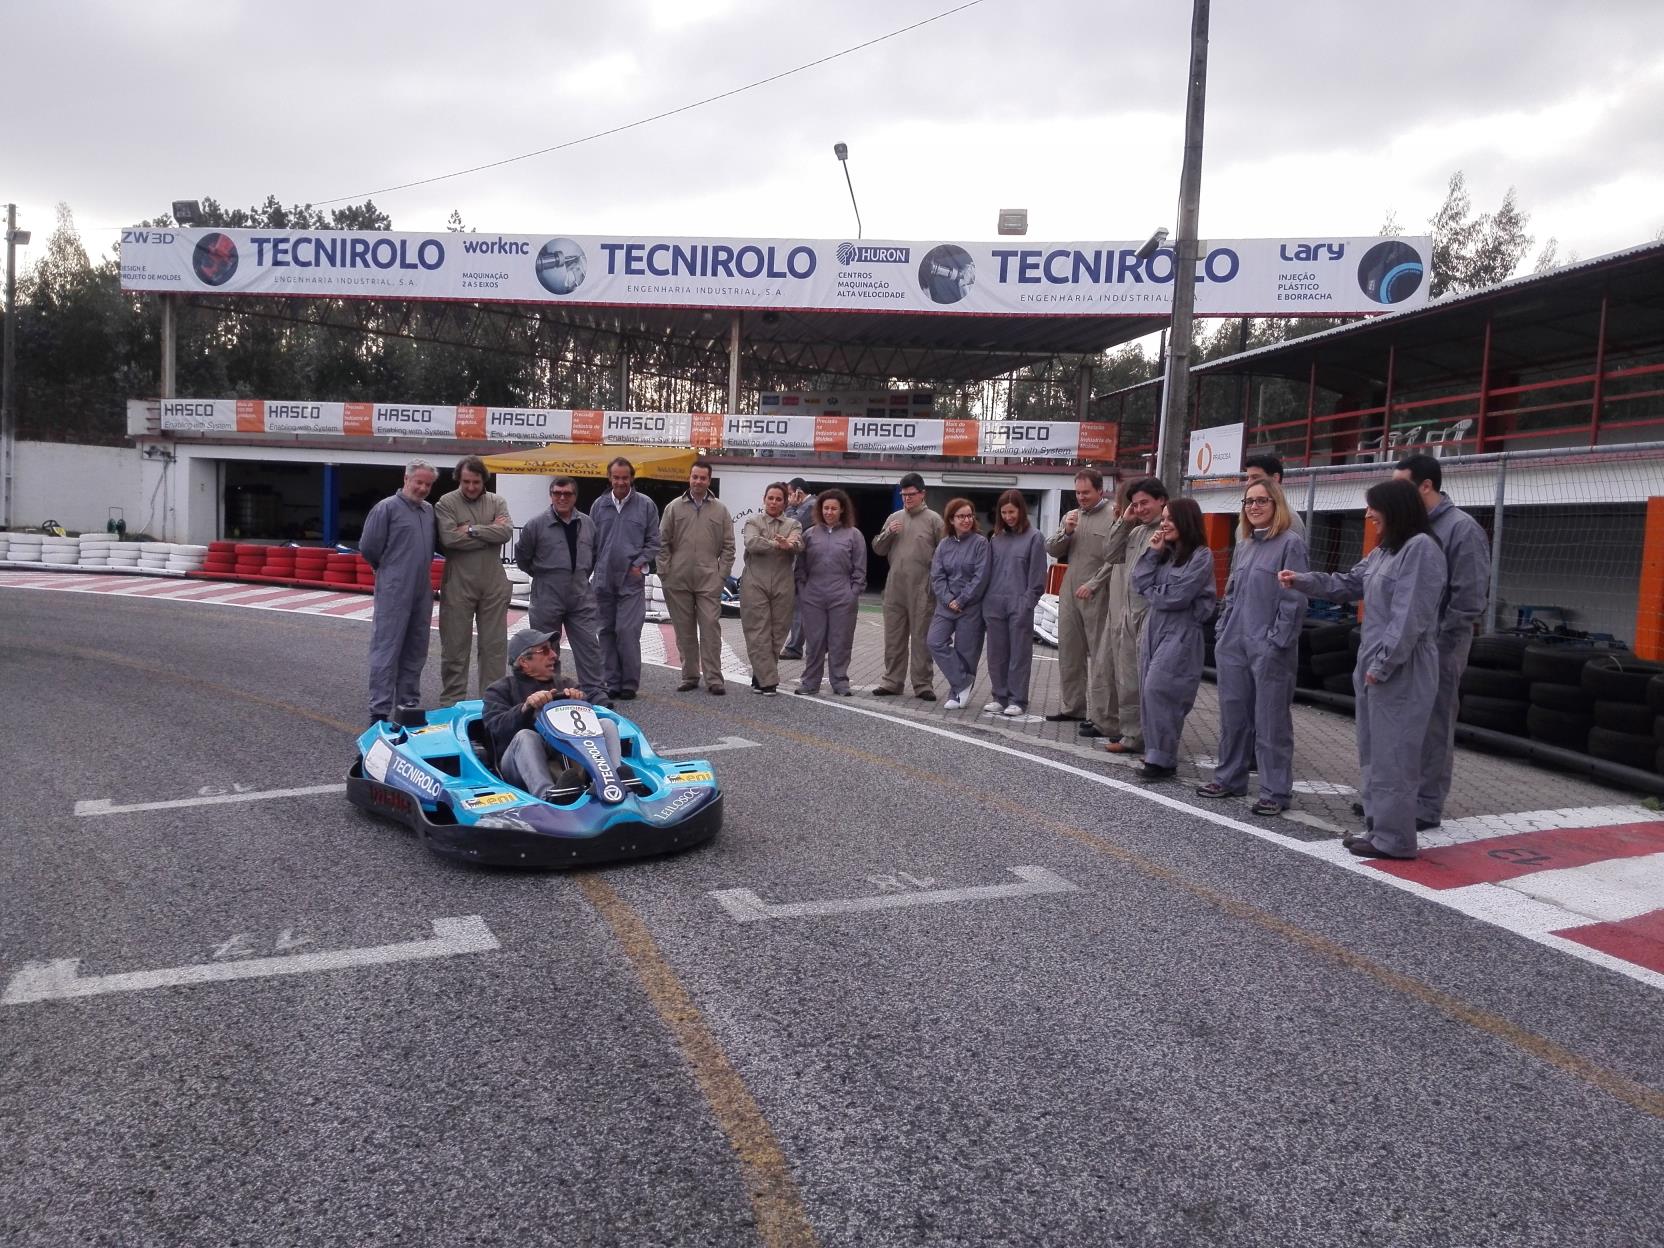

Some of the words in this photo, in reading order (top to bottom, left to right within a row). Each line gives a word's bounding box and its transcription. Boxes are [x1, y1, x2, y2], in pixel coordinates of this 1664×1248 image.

[250, 237, 446, 270] TECNIROLO
[861, 248, 906, 262] HURON
[600, 243, 817, 279] TECNIROLO
[992, 248, 1240, 285] TECNIROO
[274, 276, 333, 285] ENGENHARIA
[462, 272, 509, 280] MAQUINAÇÃO
[1278, 272, 1316, 282] INJEÇÃO
[627, 285, 691, 294] ENGENHARIA
[837, 281, 890, 290] MAQUINAÇÃO
[1277, 282, 1320, 291] PLÁSTICO
[836, 290, 856, 298] ALTA
[858, 291, 905, 299] VELOCIDADE
[1020, 294, 1094, 302] ENGENHARIA
[1277, 293, 1283, 301] E
[1284, 293, 1333, 301] BORRACHA
[164, 403, 214, 417] HASCO
[269, 405, 321, 419] HASCO
[377, 409, 432, 422] HASCO
[491, 412, 547, 426] HASCO
[608, 416, 665, 430] HASCO
[728, 420, 788, 434] HASCO
[853, 422, 916, 437] HASCO
[853, 441, 887, 452] Enabling
[888, 442, 905, 451] with
[570, 710, 586, 731] 8
[584, 740, 616, 785] TECNIROLO
[391, 756, 441, 798] TECNIROLO
